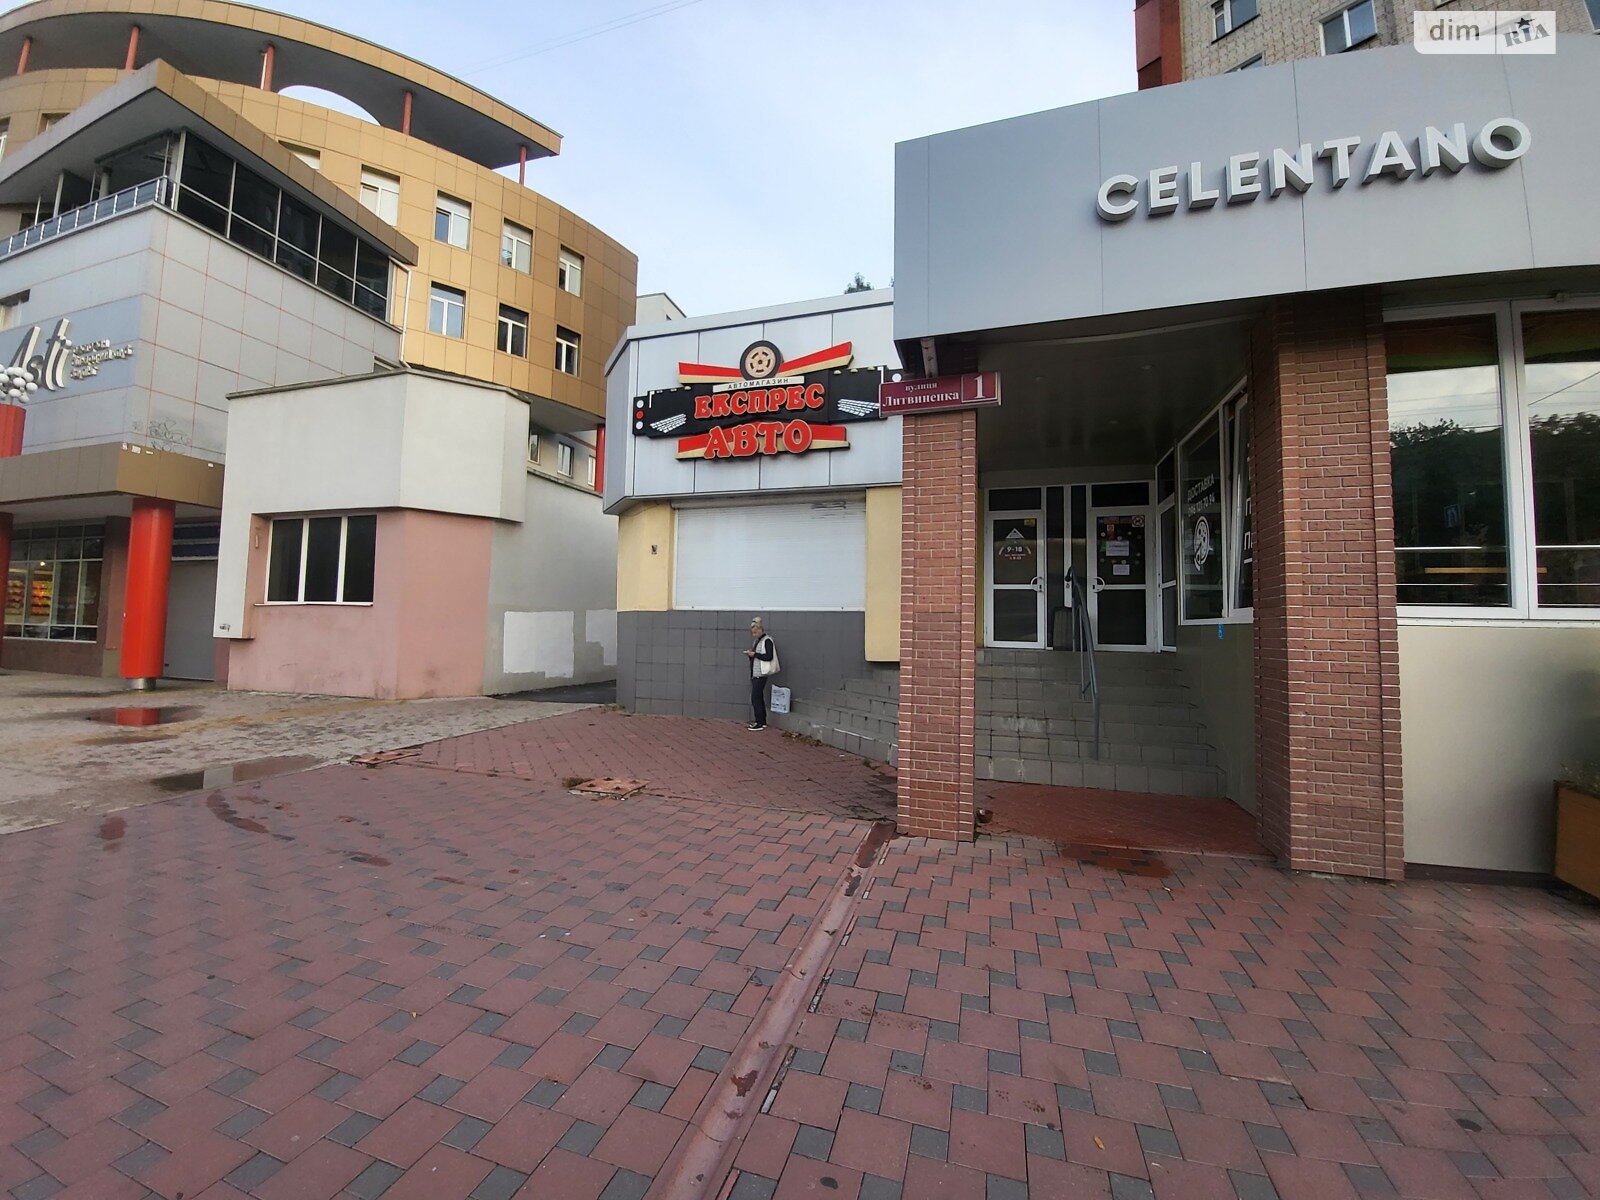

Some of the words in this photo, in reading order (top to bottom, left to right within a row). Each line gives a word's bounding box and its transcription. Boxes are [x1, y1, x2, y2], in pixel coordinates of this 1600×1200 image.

[1097, 117, 1533, 222] CELENTANO
[727, 378, 789, 390] АВТОМАГАЗИН
[905, 382, 938, 393] вулиця
[974, 375, 986, 399] 1
[694, 383, 825, 419] ЕКСПРЕС
[882, 391, 959, 407] Литвиненка
[704, 419, 813, 459] АВТО
